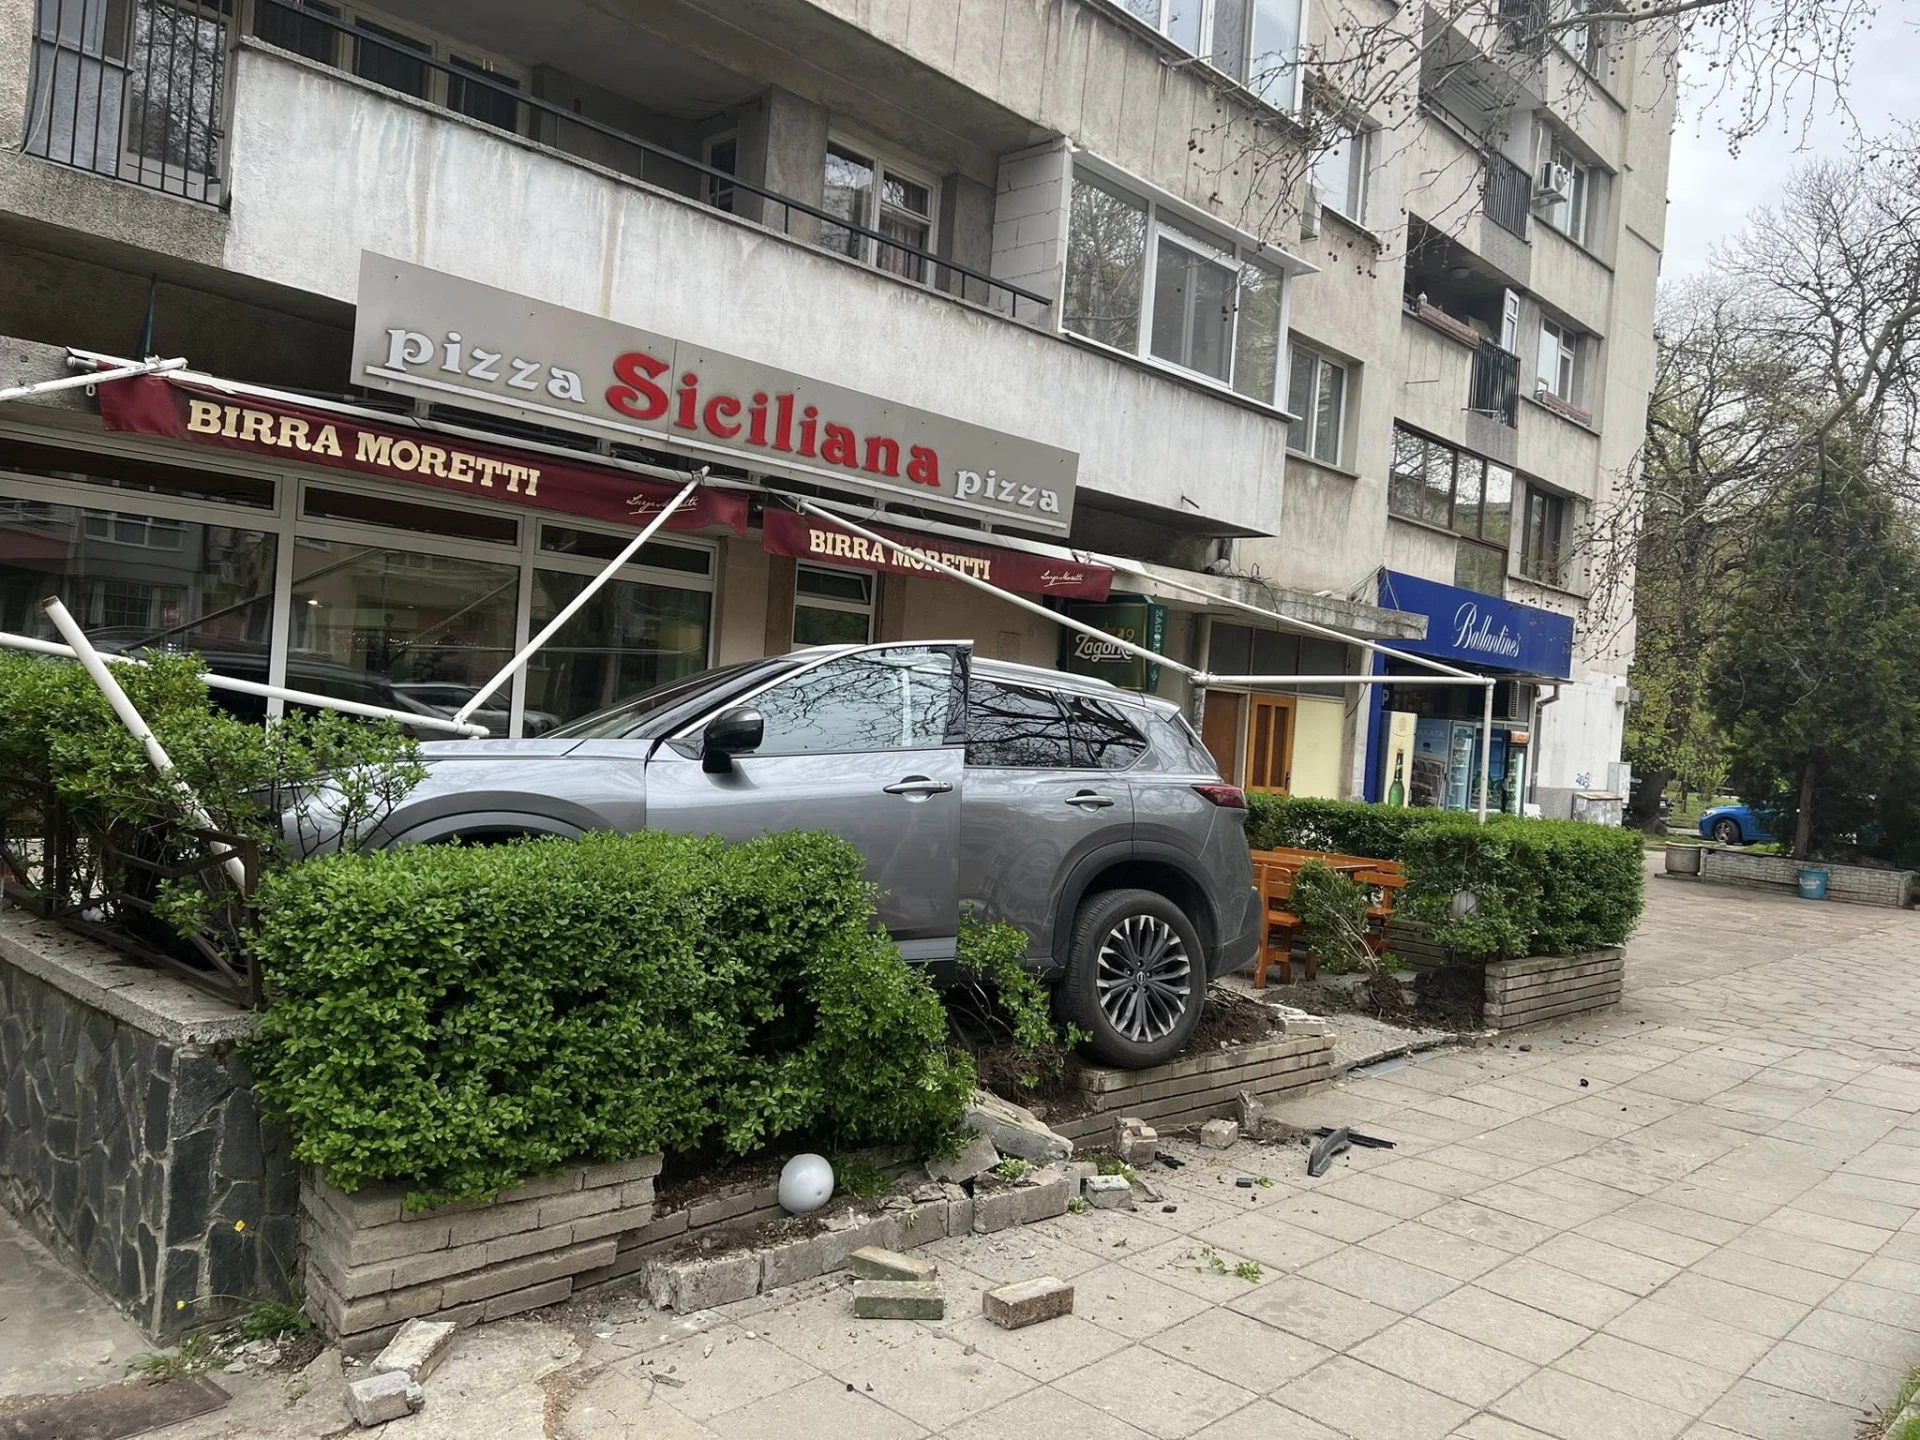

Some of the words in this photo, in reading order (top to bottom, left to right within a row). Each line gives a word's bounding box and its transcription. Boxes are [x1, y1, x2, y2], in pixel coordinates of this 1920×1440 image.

[187, 400, 342, 457] BIRRA
[355, 431, 541, 496] MORETTI
[385, 328, 585, 403] pizza
[605, 352, 941, 487] Siciliana
[954, 469, 1060, 514] pizza
[809, 528, 886, 563] BIRRA
